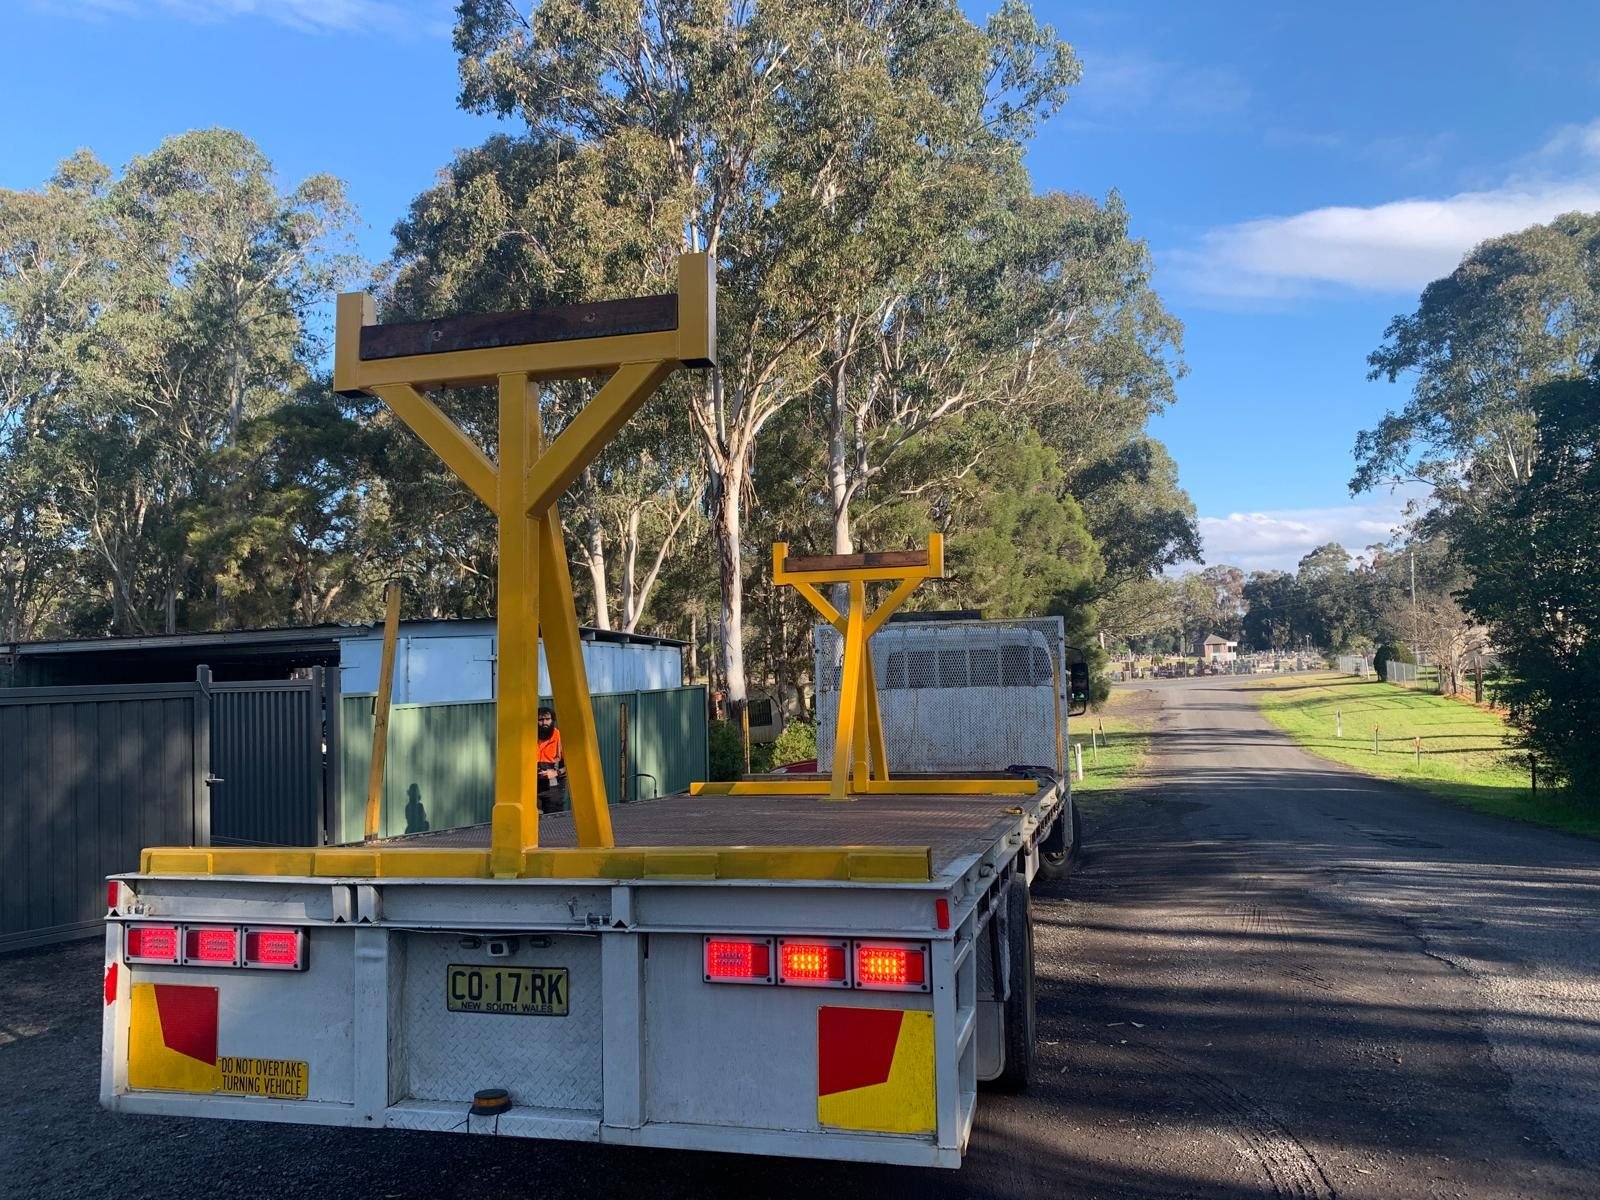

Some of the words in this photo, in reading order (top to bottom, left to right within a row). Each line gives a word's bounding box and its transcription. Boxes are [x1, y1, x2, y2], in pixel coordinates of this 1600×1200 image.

[462, 1002, 481, 1010] NEW
[486, 1003, 517, 1012] SOUTH
[522, 1004, 553, 1013] WALES
[222, 1058, 233, 1073] DO
[236, 1058, 254, 1075] NOT
[256, 1060, 302, 1078] OVERTAKE
[223, 1076, 260, 1093] TURNING
[264, 1079, 302, 1096] VEHICLE
